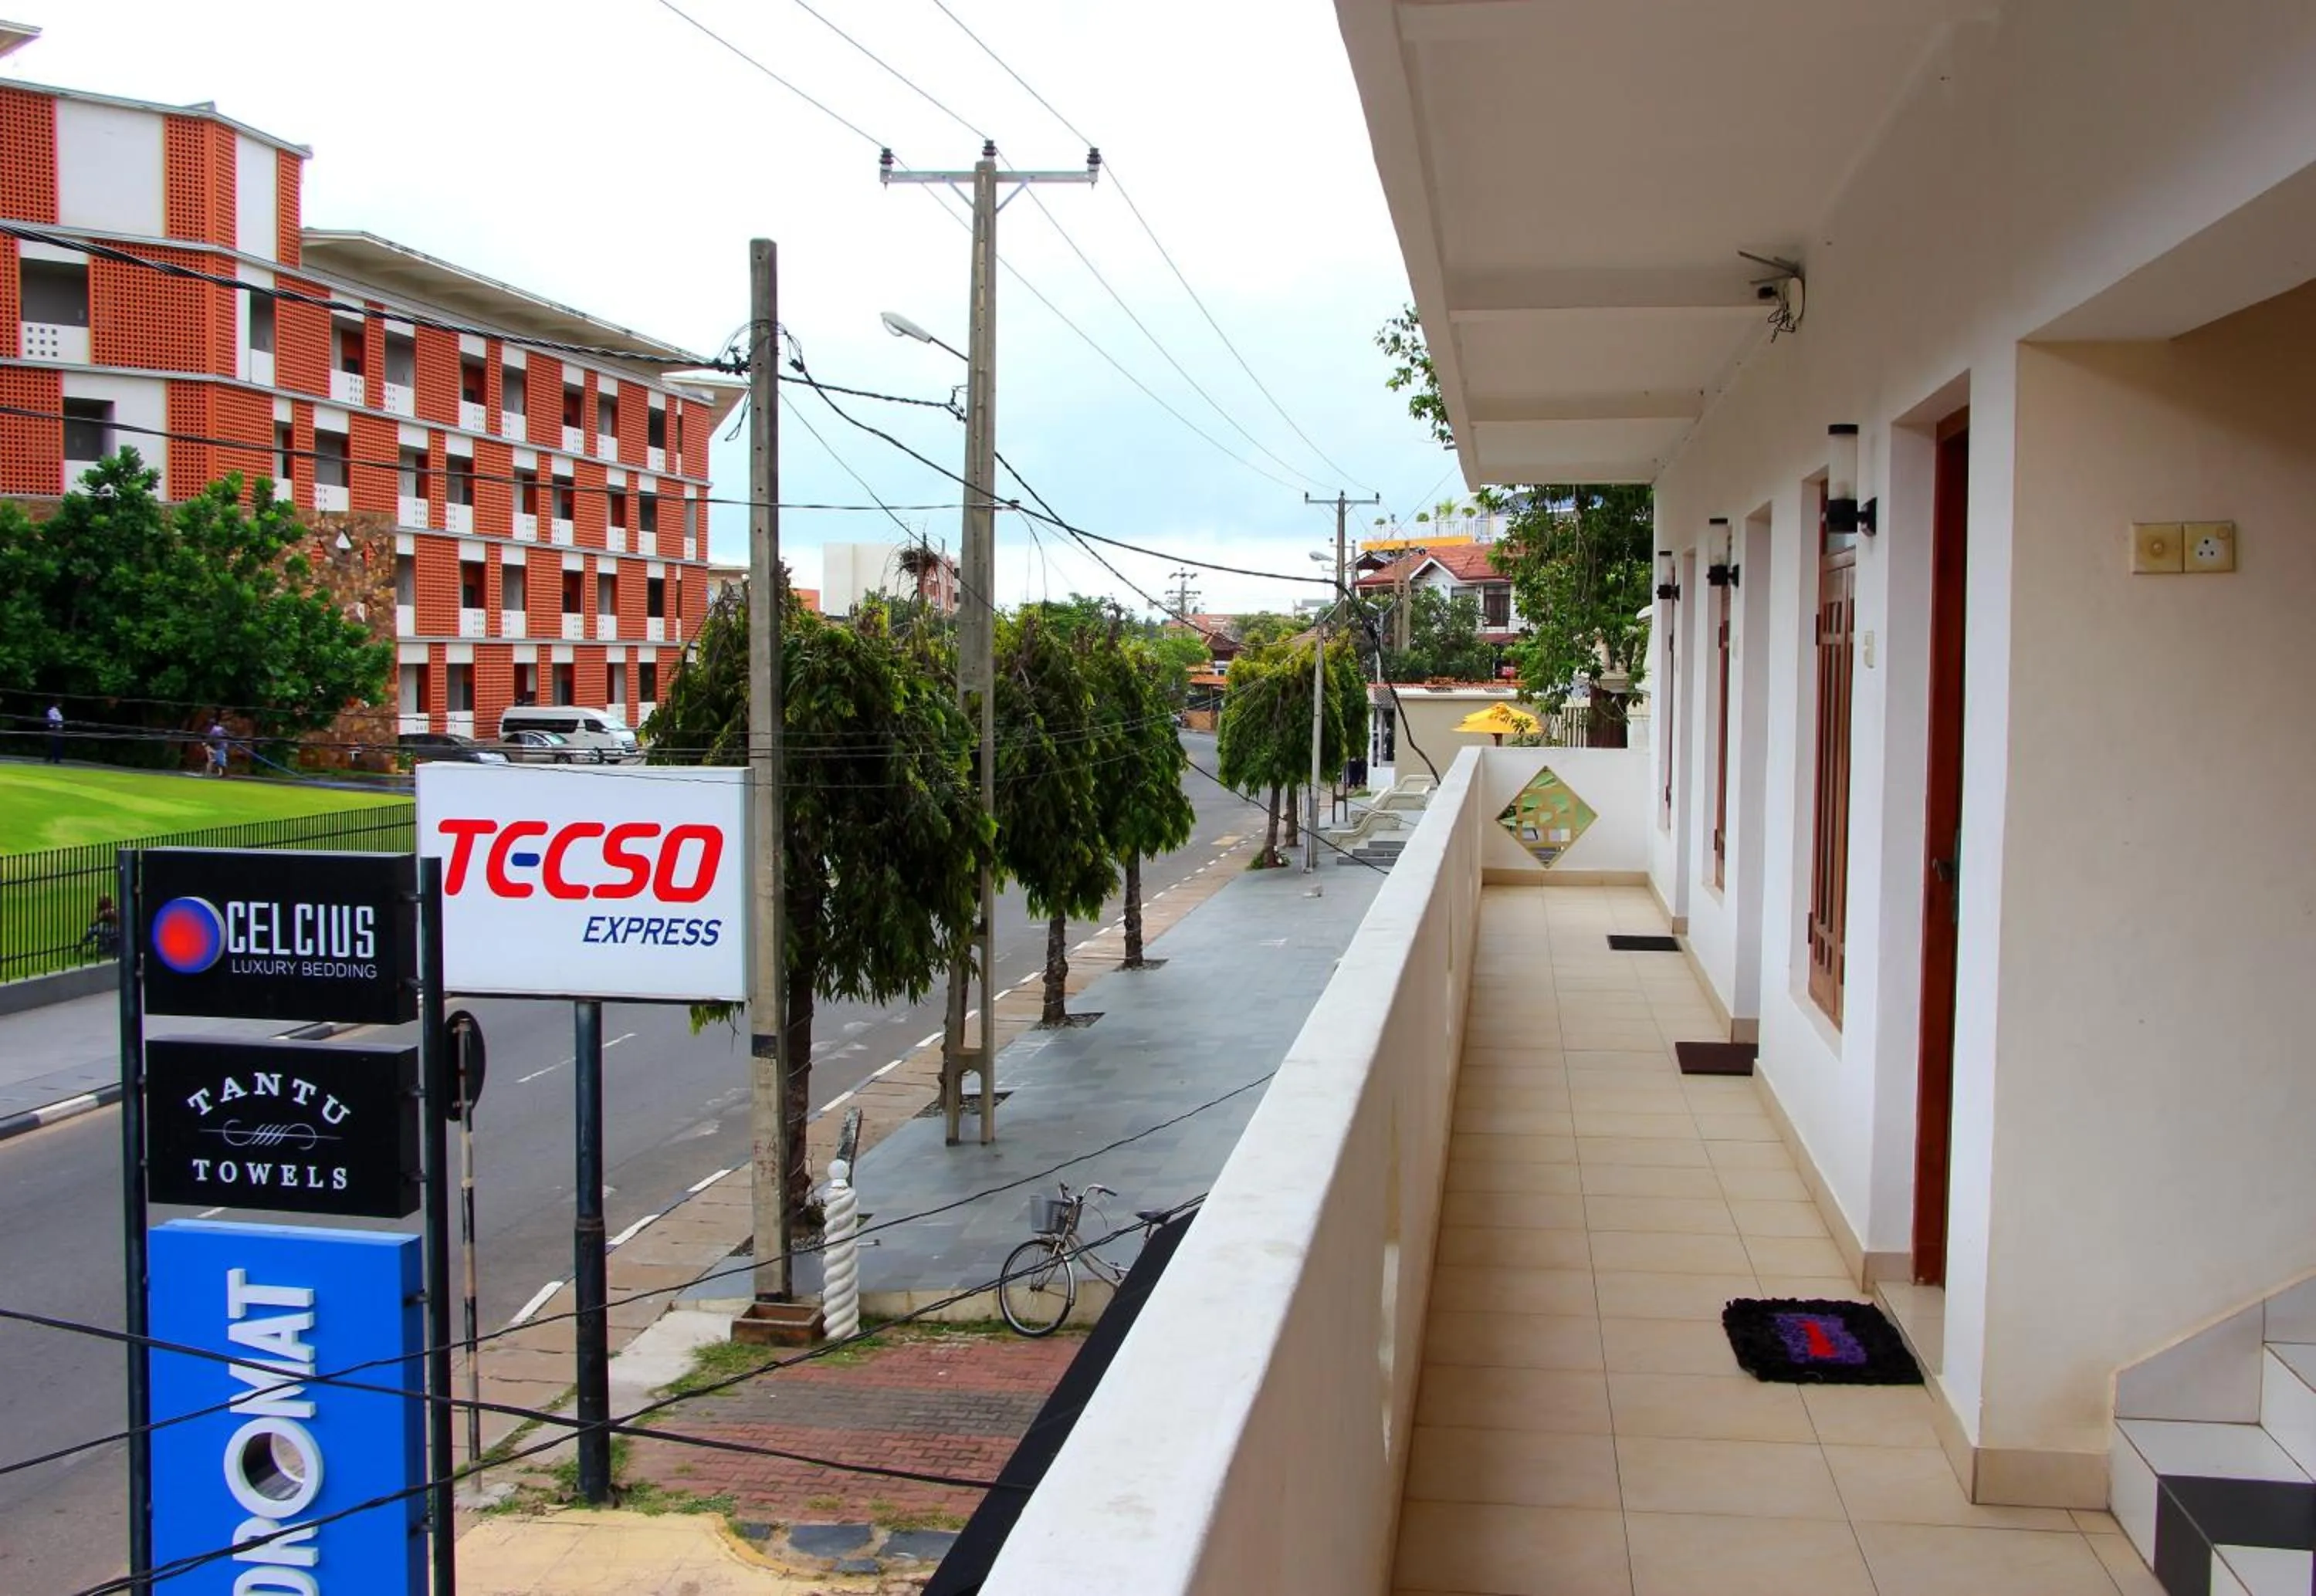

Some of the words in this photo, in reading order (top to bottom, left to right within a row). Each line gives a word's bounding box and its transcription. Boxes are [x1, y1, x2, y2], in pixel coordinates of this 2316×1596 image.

[438, 819, 724, 903] TECSO
[227, 901, 375, 958] CELCIUS
[582, 915, 722, 947] EXPRESS
[232, 959, 297, 975] LUXURY
[302, 962, 378, 979] BEDDING
[187, 1072, 350, 1124] TANTU
[192, 1159, 347, 1189] TOWELS
